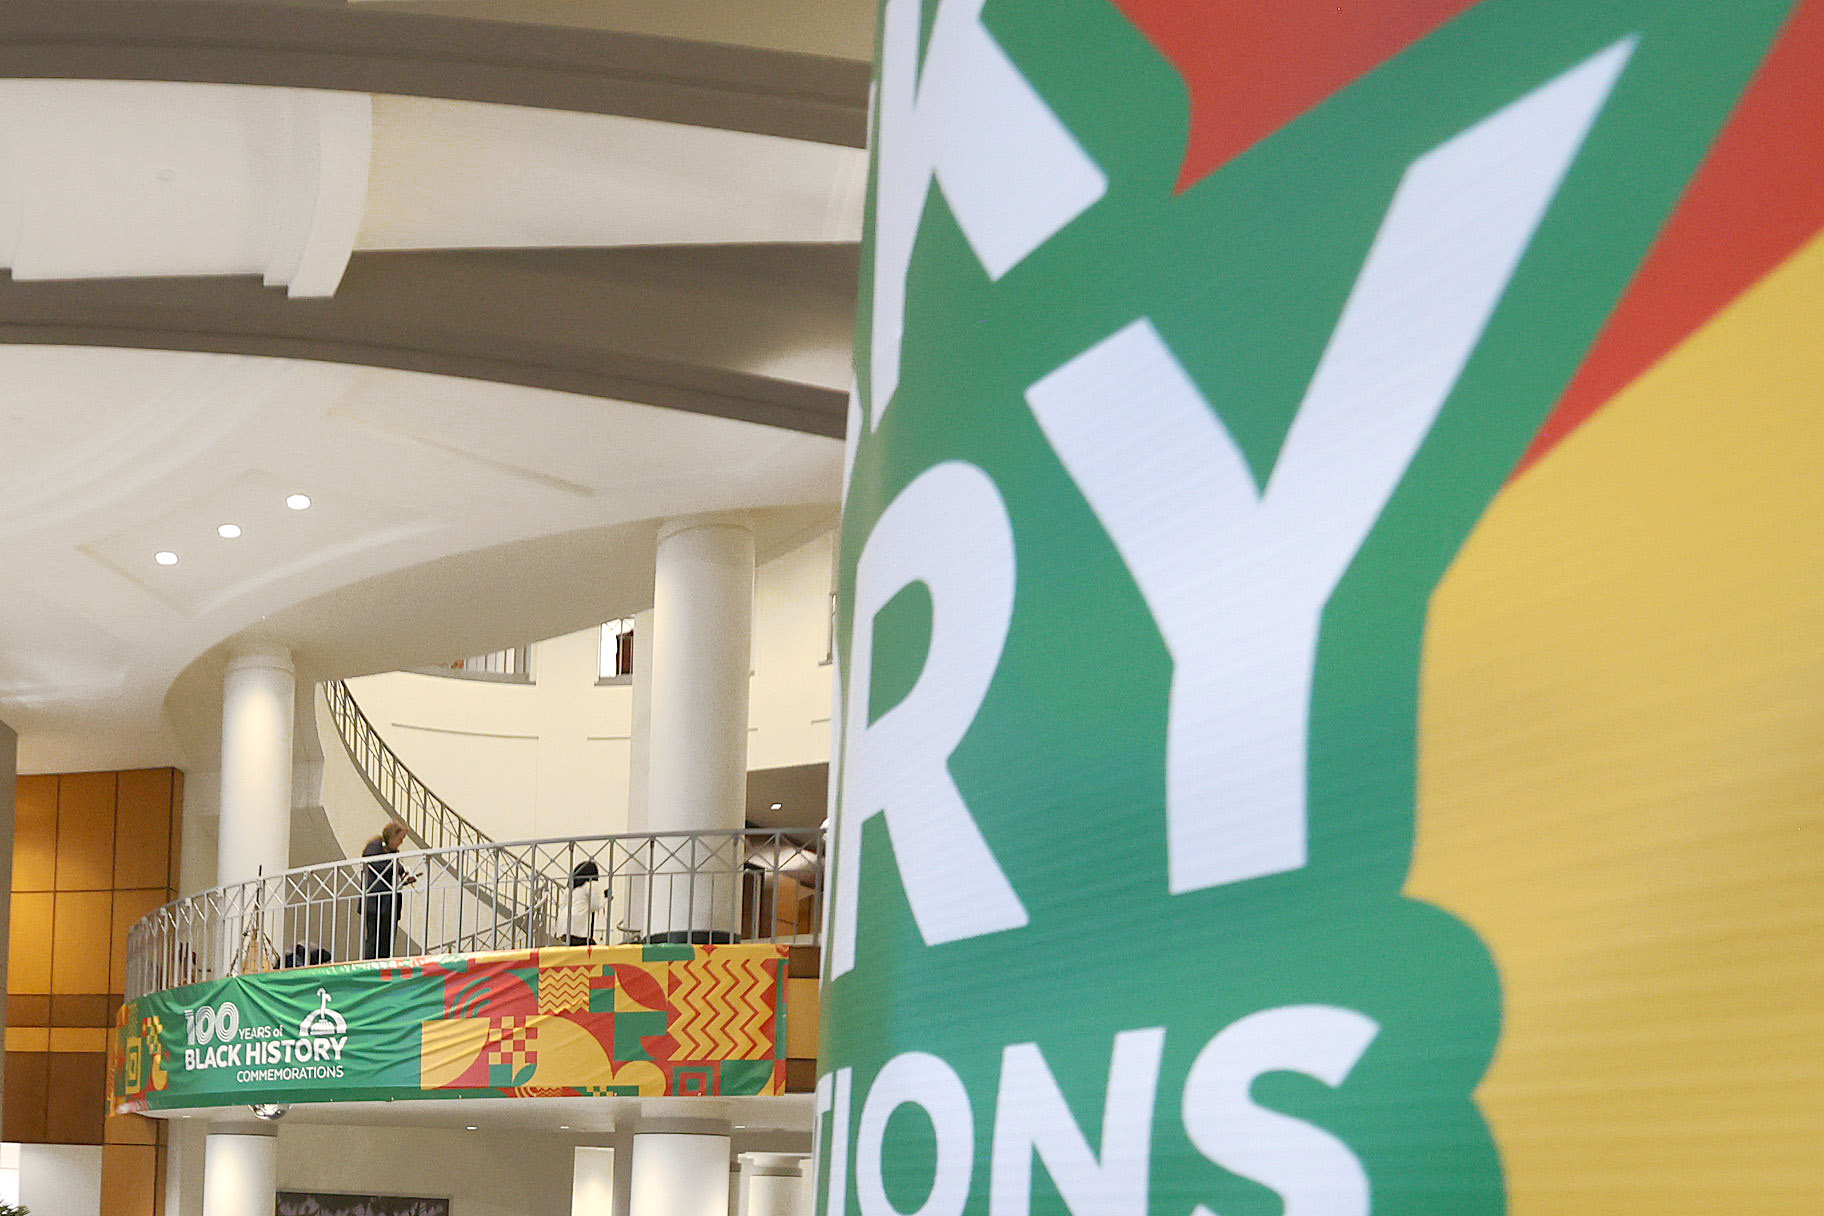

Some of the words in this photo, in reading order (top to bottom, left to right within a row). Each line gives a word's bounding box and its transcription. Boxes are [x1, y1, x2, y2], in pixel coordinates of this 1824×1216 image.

[820, 34, 1640, 981] RY
[184, 1002, 240, 1045] 100
[239, 1026, 271, 1040] YEARS
[273, 1024, 284, 1037] of
[184, 1043, 242, 1071] BLACK
[246, 1036, 348, 1065] HISTORY
[236, 1065, 345, 1083] COMMEMORATIONS
